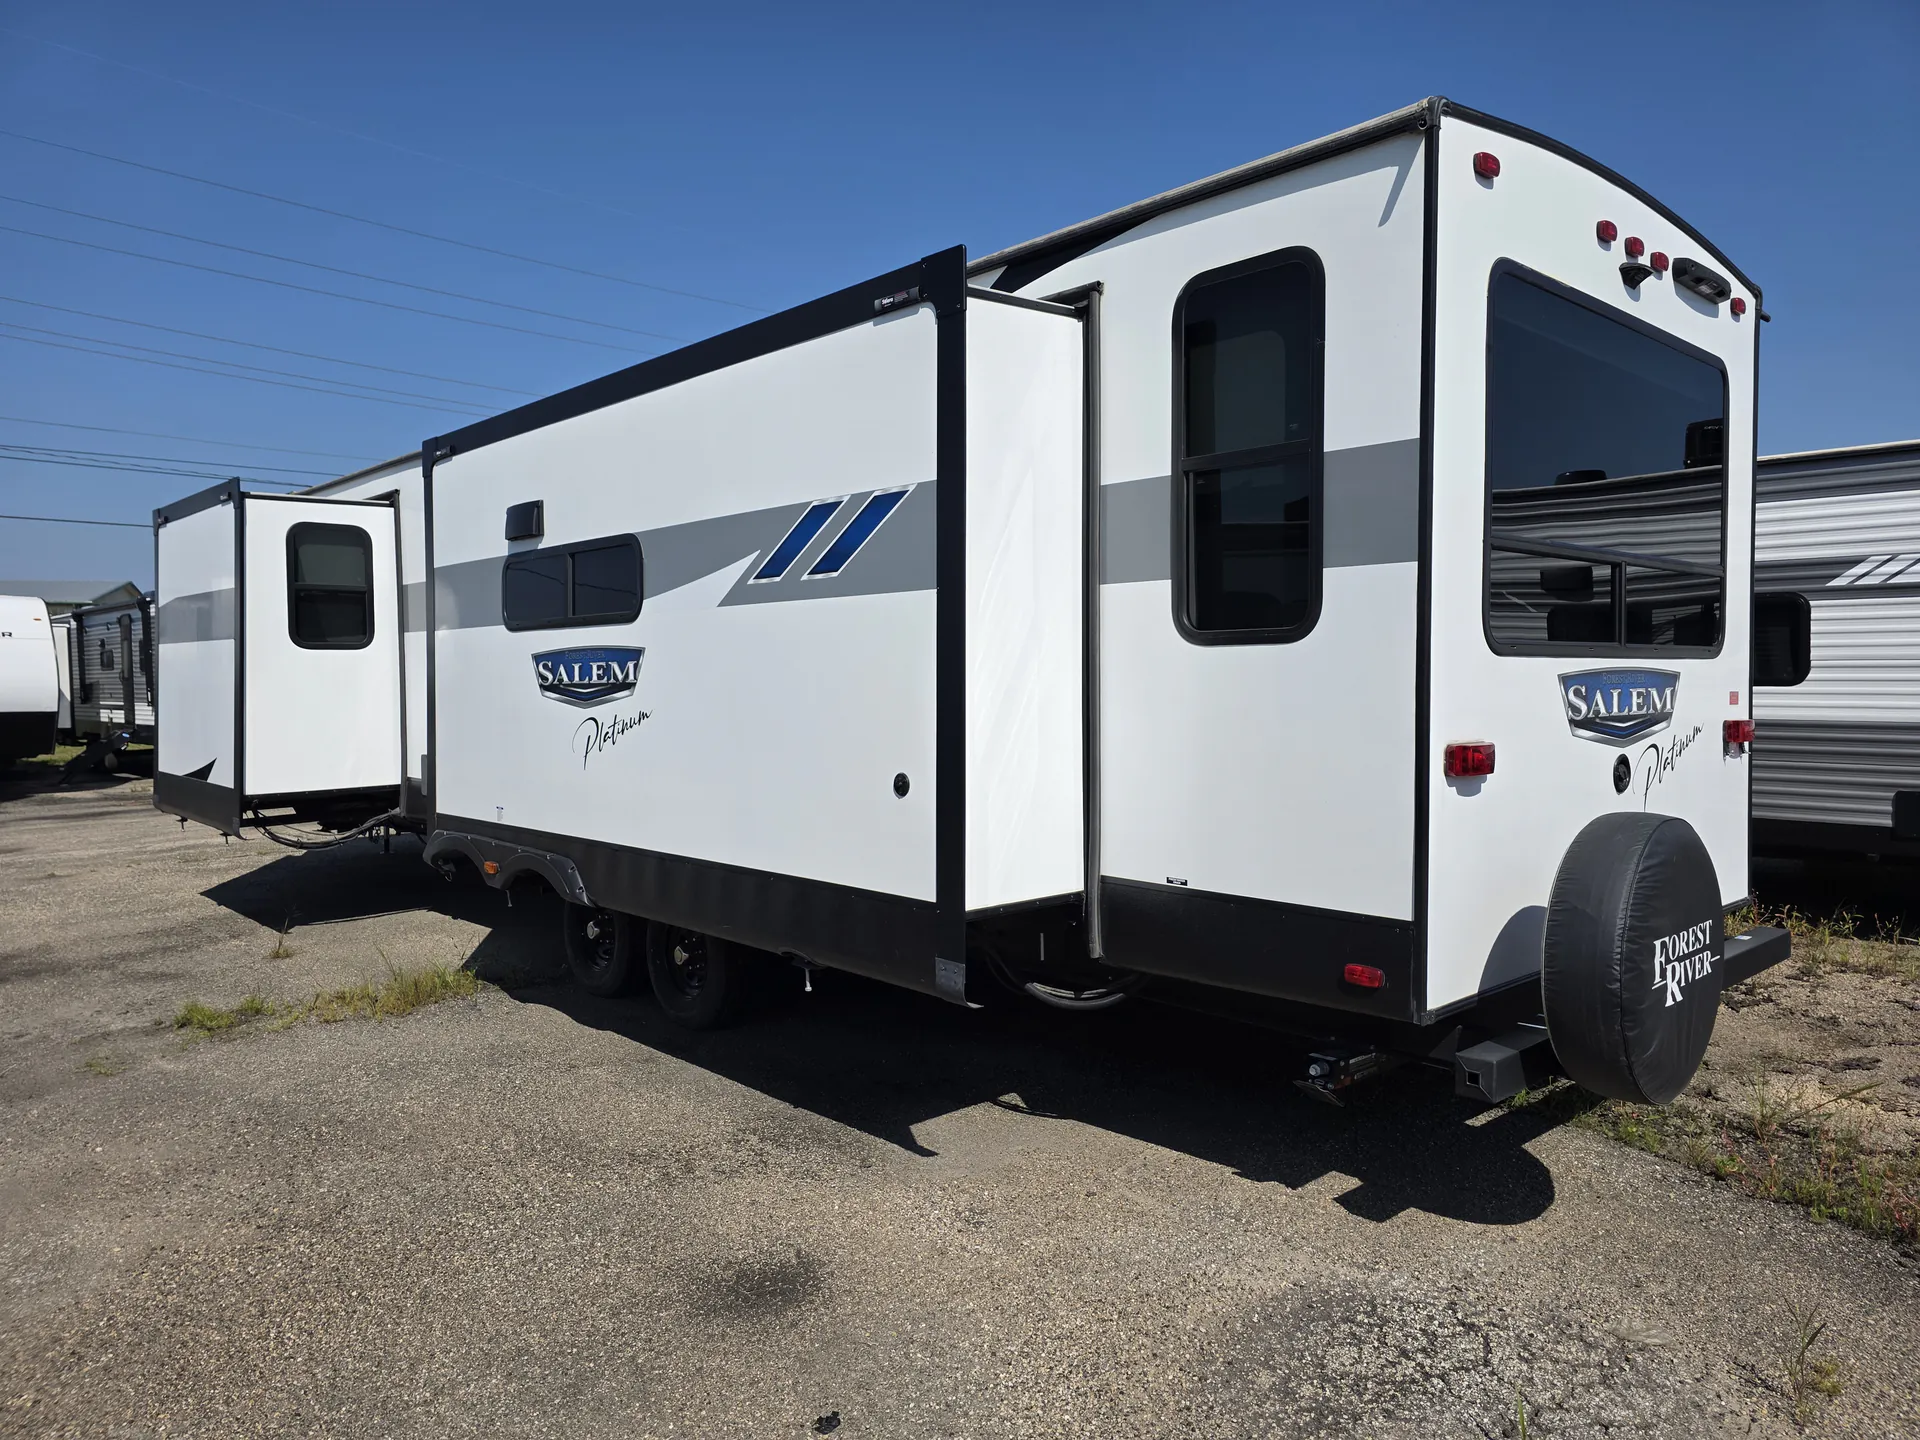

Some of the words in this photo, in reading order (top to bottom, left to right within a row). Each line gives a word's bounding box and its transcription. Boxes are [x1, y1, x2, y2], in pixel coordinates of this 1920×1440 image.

[538, 660, 638, 686] SALEM
[1567, 685, 1674, 720] SALEM
[572, 709, 655, 771] Platinum
[1632, 722, 1704, 812] Platinum
[1653, 919, 1713, 985] FOREST
[1665, 950, 1712, 1007] RIVER
